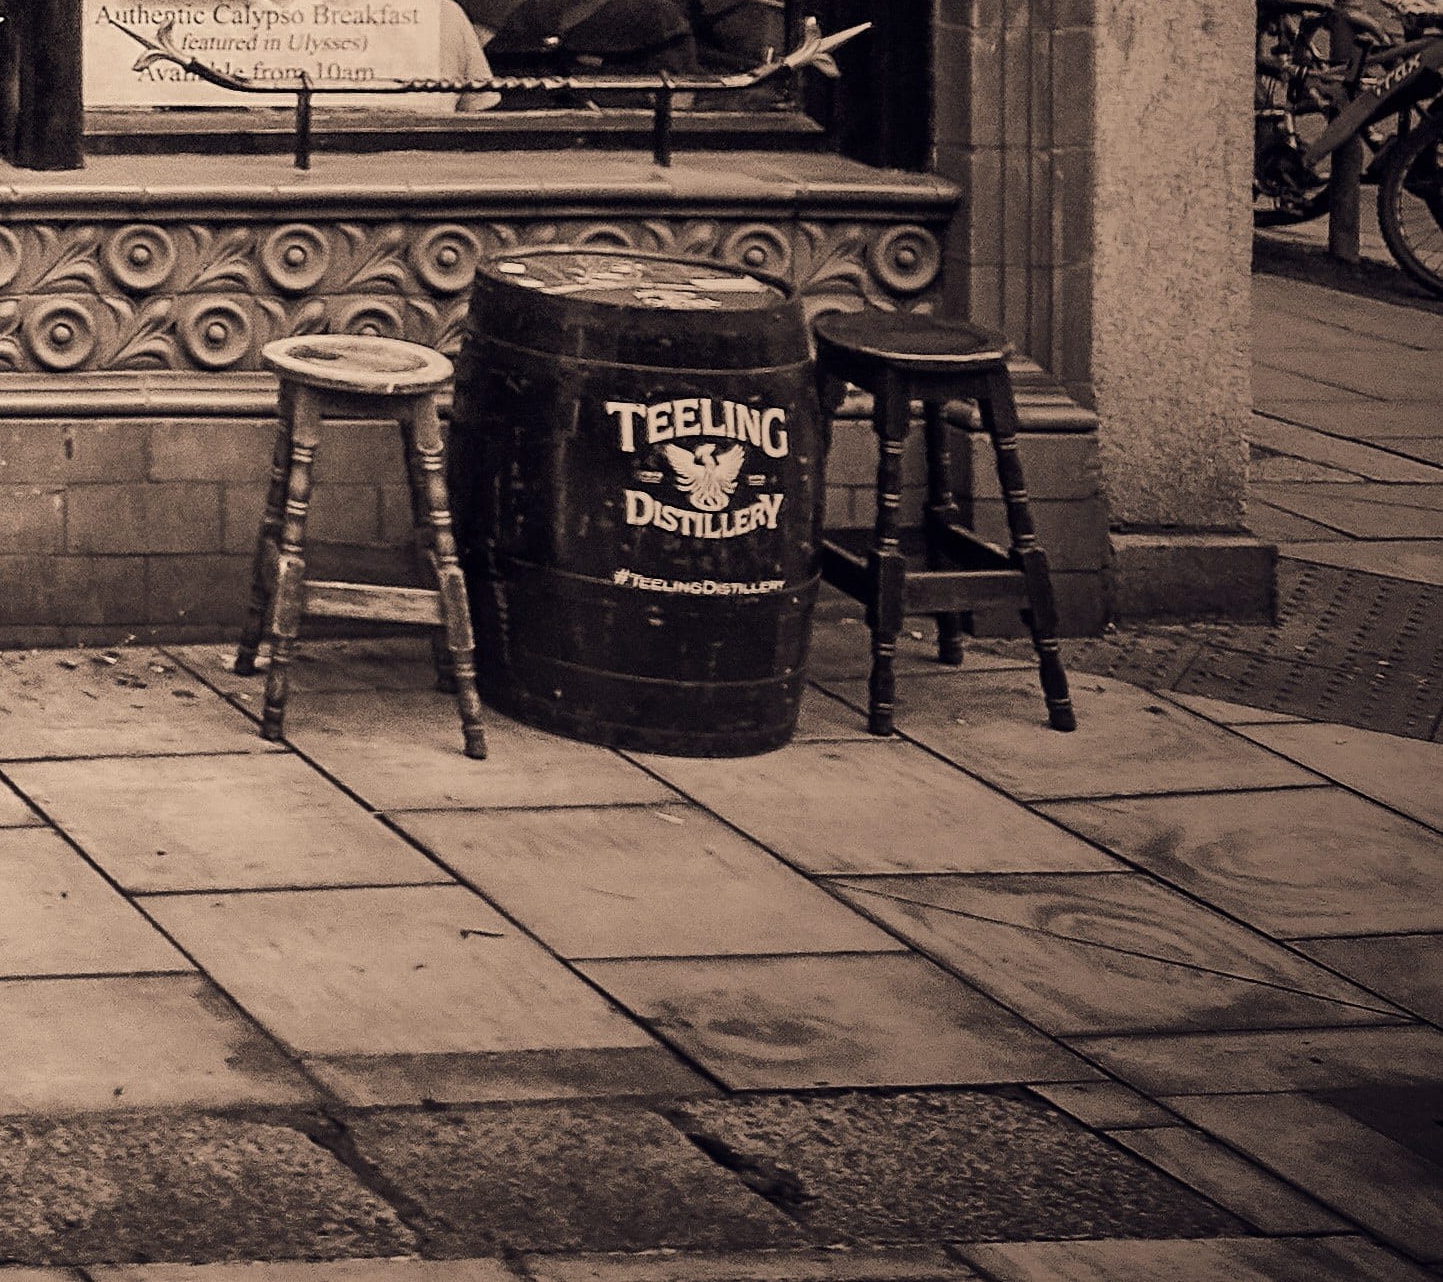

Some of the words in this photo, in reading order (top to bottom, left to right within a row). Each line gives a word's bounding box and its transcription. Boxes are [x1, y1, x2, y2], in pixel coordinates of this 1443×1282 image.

[95, 4, 205, 26] Authentic
[213, 3, 304, 30] Calypso
[312, 4, 419, 26] Breakfast
[182, 32, 256, 51] featured
[263, 33, 281, 50] in
[315, 62, 375, 81] 10am
[605, 397, 789, 459] TEELING
[624, 489, 785, 539] DISTILLERY
